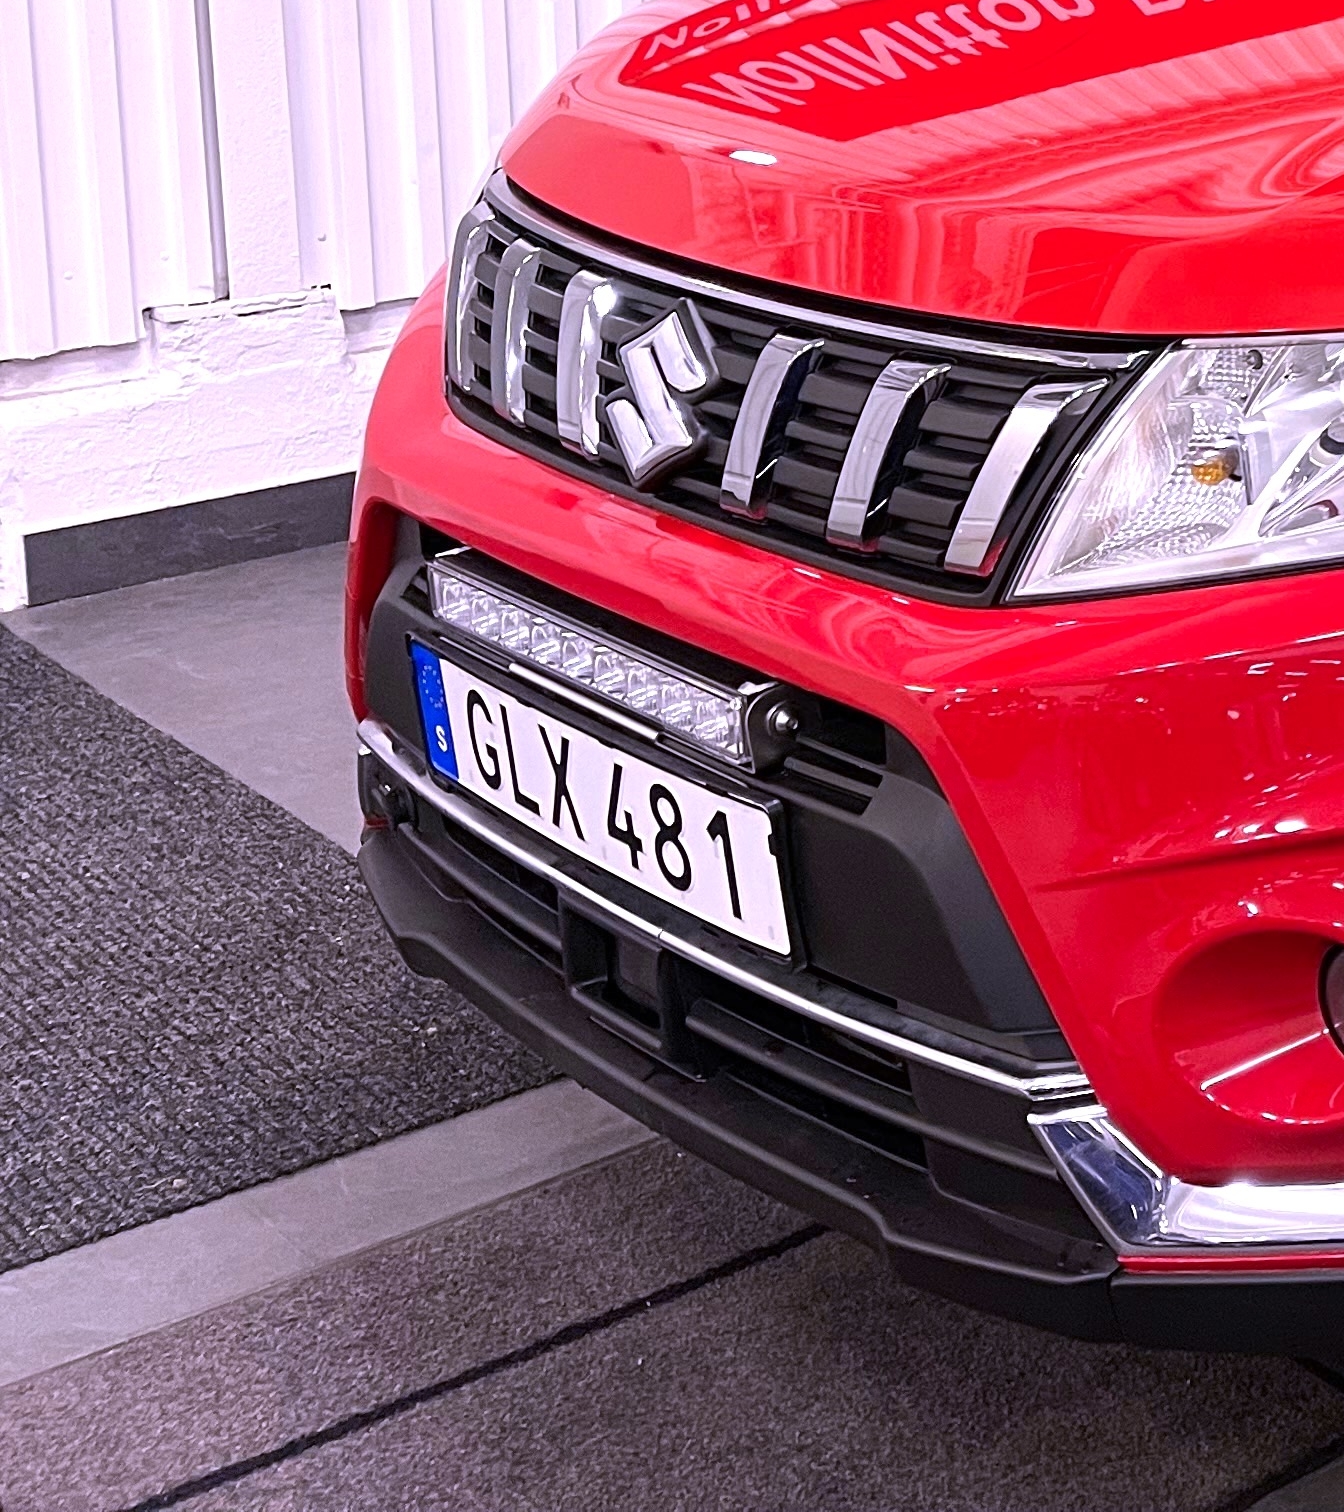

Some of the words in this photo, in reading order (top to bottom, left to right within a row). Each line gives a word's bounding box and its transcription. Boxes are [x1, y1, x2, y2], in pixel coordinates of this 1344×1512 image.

[435, 724, 448, 752] S
[466, 688, 586, 842] GLX
[606, 762, 743, 920] 481
